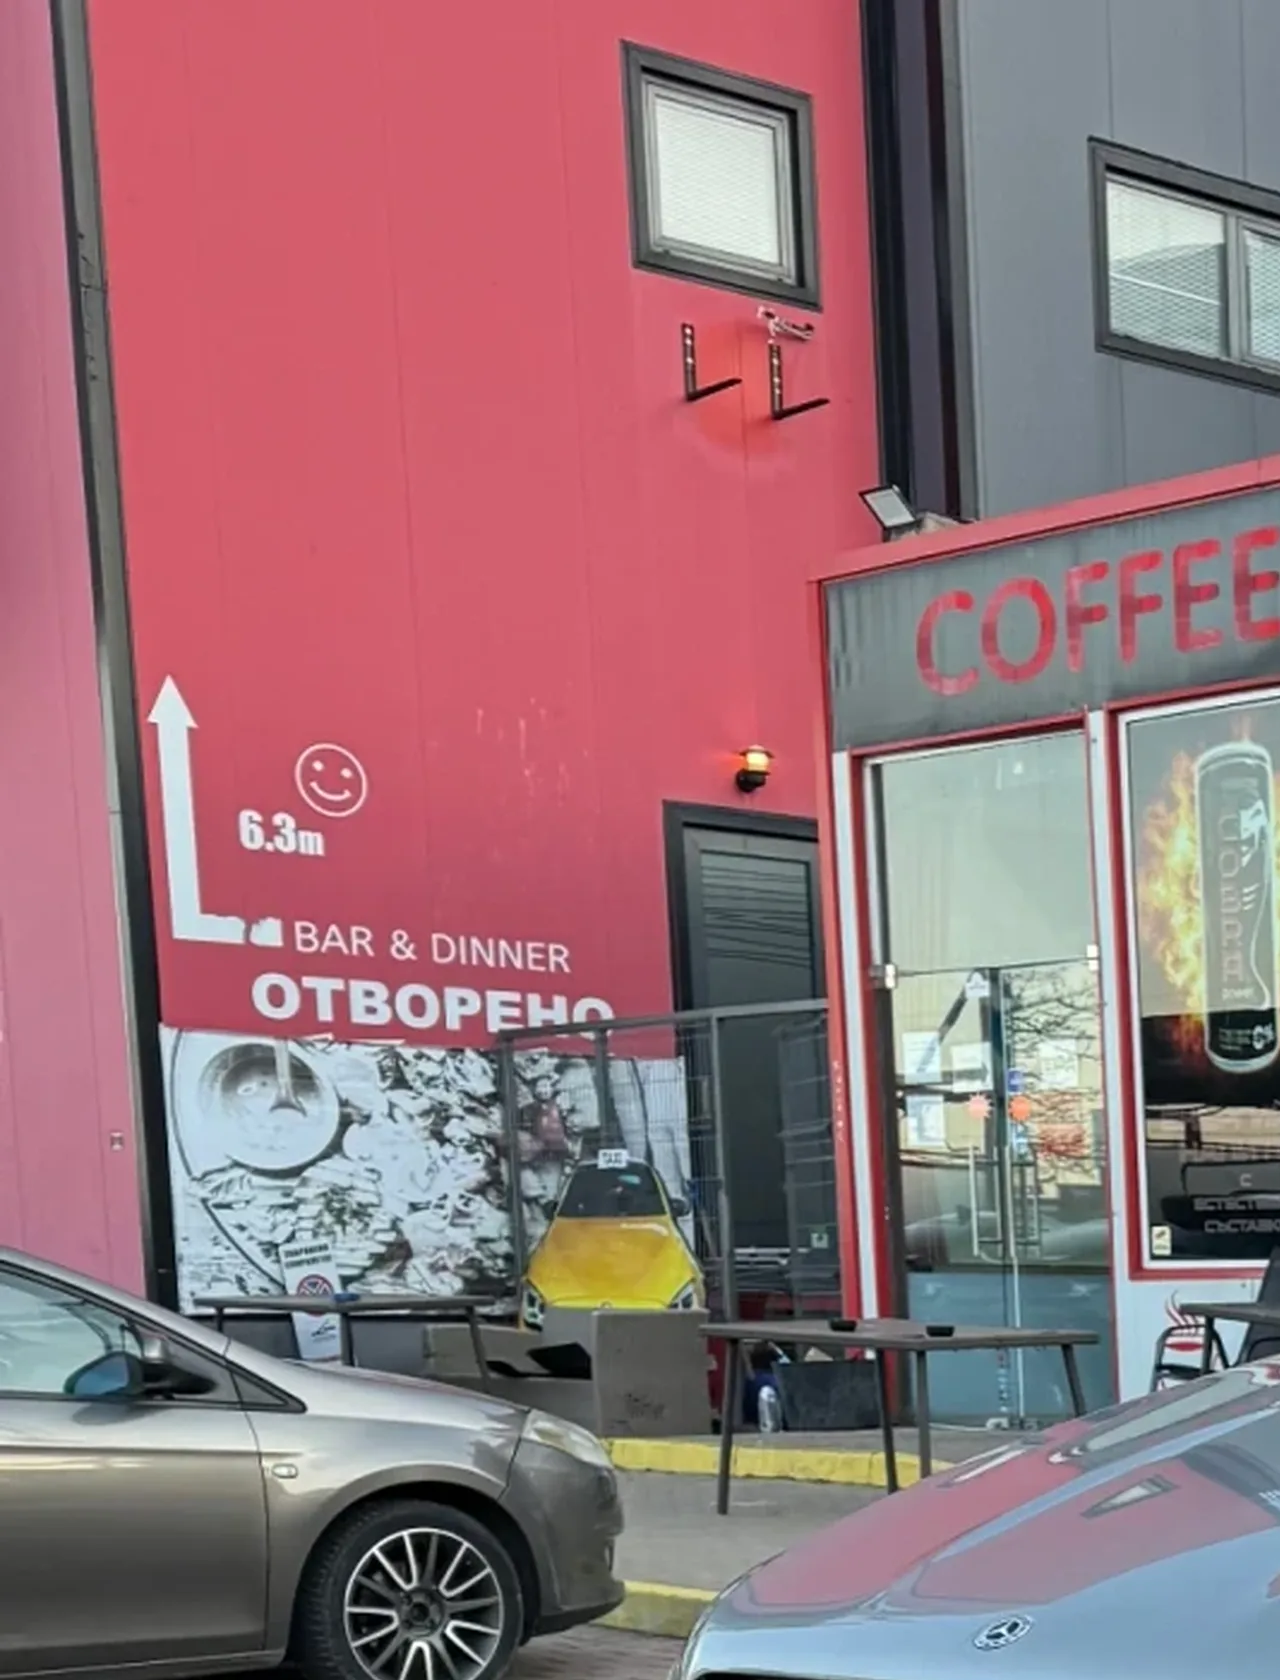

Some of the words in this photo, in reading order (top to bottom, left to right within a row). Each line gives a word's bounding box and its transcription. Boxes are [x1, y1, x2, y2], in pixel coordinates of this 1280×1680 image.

[238, 808, 325, 856] 6.3m
[294, 920, 374, 957] BAR
[390, 928, 417, 961] &
[431, 932, 571, 973] DINNER
[251, 972, 616, 1037] ОТВОРЕНО
